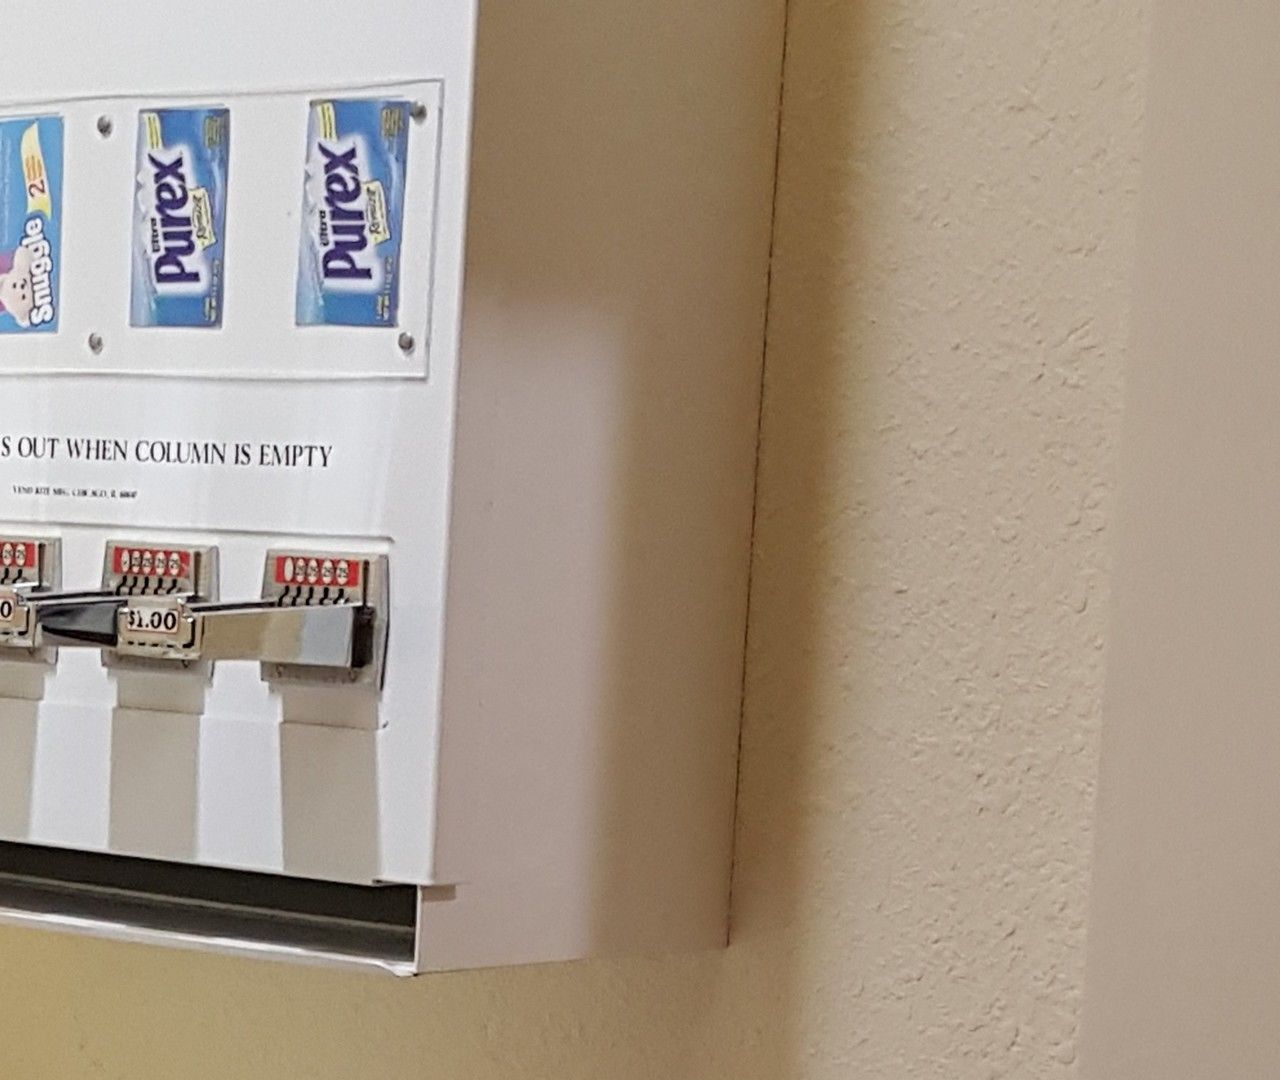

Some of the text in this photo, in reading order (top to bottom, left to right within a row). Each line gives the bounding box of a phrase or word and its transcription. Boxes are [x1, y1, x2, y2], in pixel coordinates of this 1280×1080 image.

[28, 179, 45, 198] 2
[148, 150, 201, 284] Purex
[317, 141, 372, 280] Purex
[21, 216, 54, 326] Snuggle
[17, 436, 59, 459] OUT
[66, 437, 128, 461] WHEN
[134, 440, 227, 465] COLUMN
[234, 443, 252, 466] IS
[258, 443, 333, 468] EMPTY
[127, 608, 177, 631] $1.00
